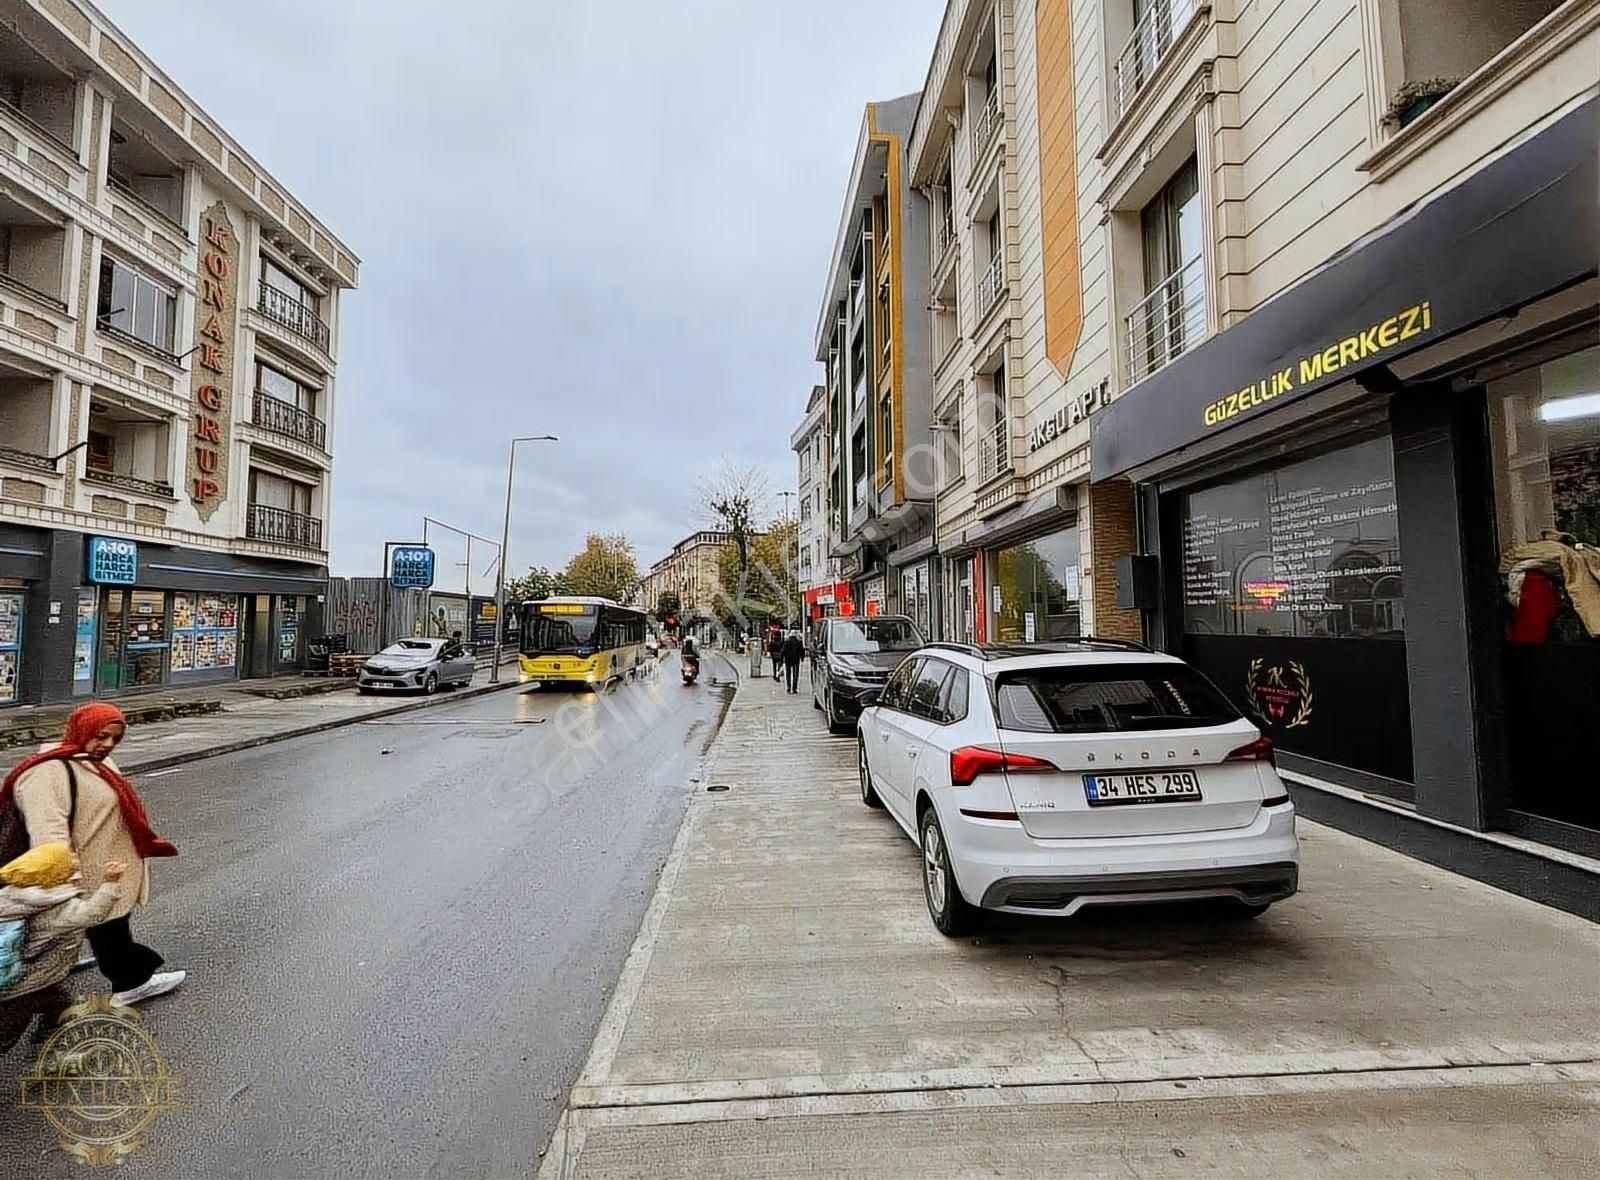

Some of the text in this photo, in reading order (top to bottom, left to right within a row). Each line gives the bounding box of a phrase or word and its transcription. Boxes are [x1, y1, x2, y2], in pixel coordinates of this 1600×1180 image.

[193, 218, 229, 503] KONAK GRUP
[1028, 408, 1067, 453] AKSU
[96, 551, 134, 564] HARCA
[96, 561, 134, 573] HARCA
[1097, 773, 1195, 797] 34 HES 299
